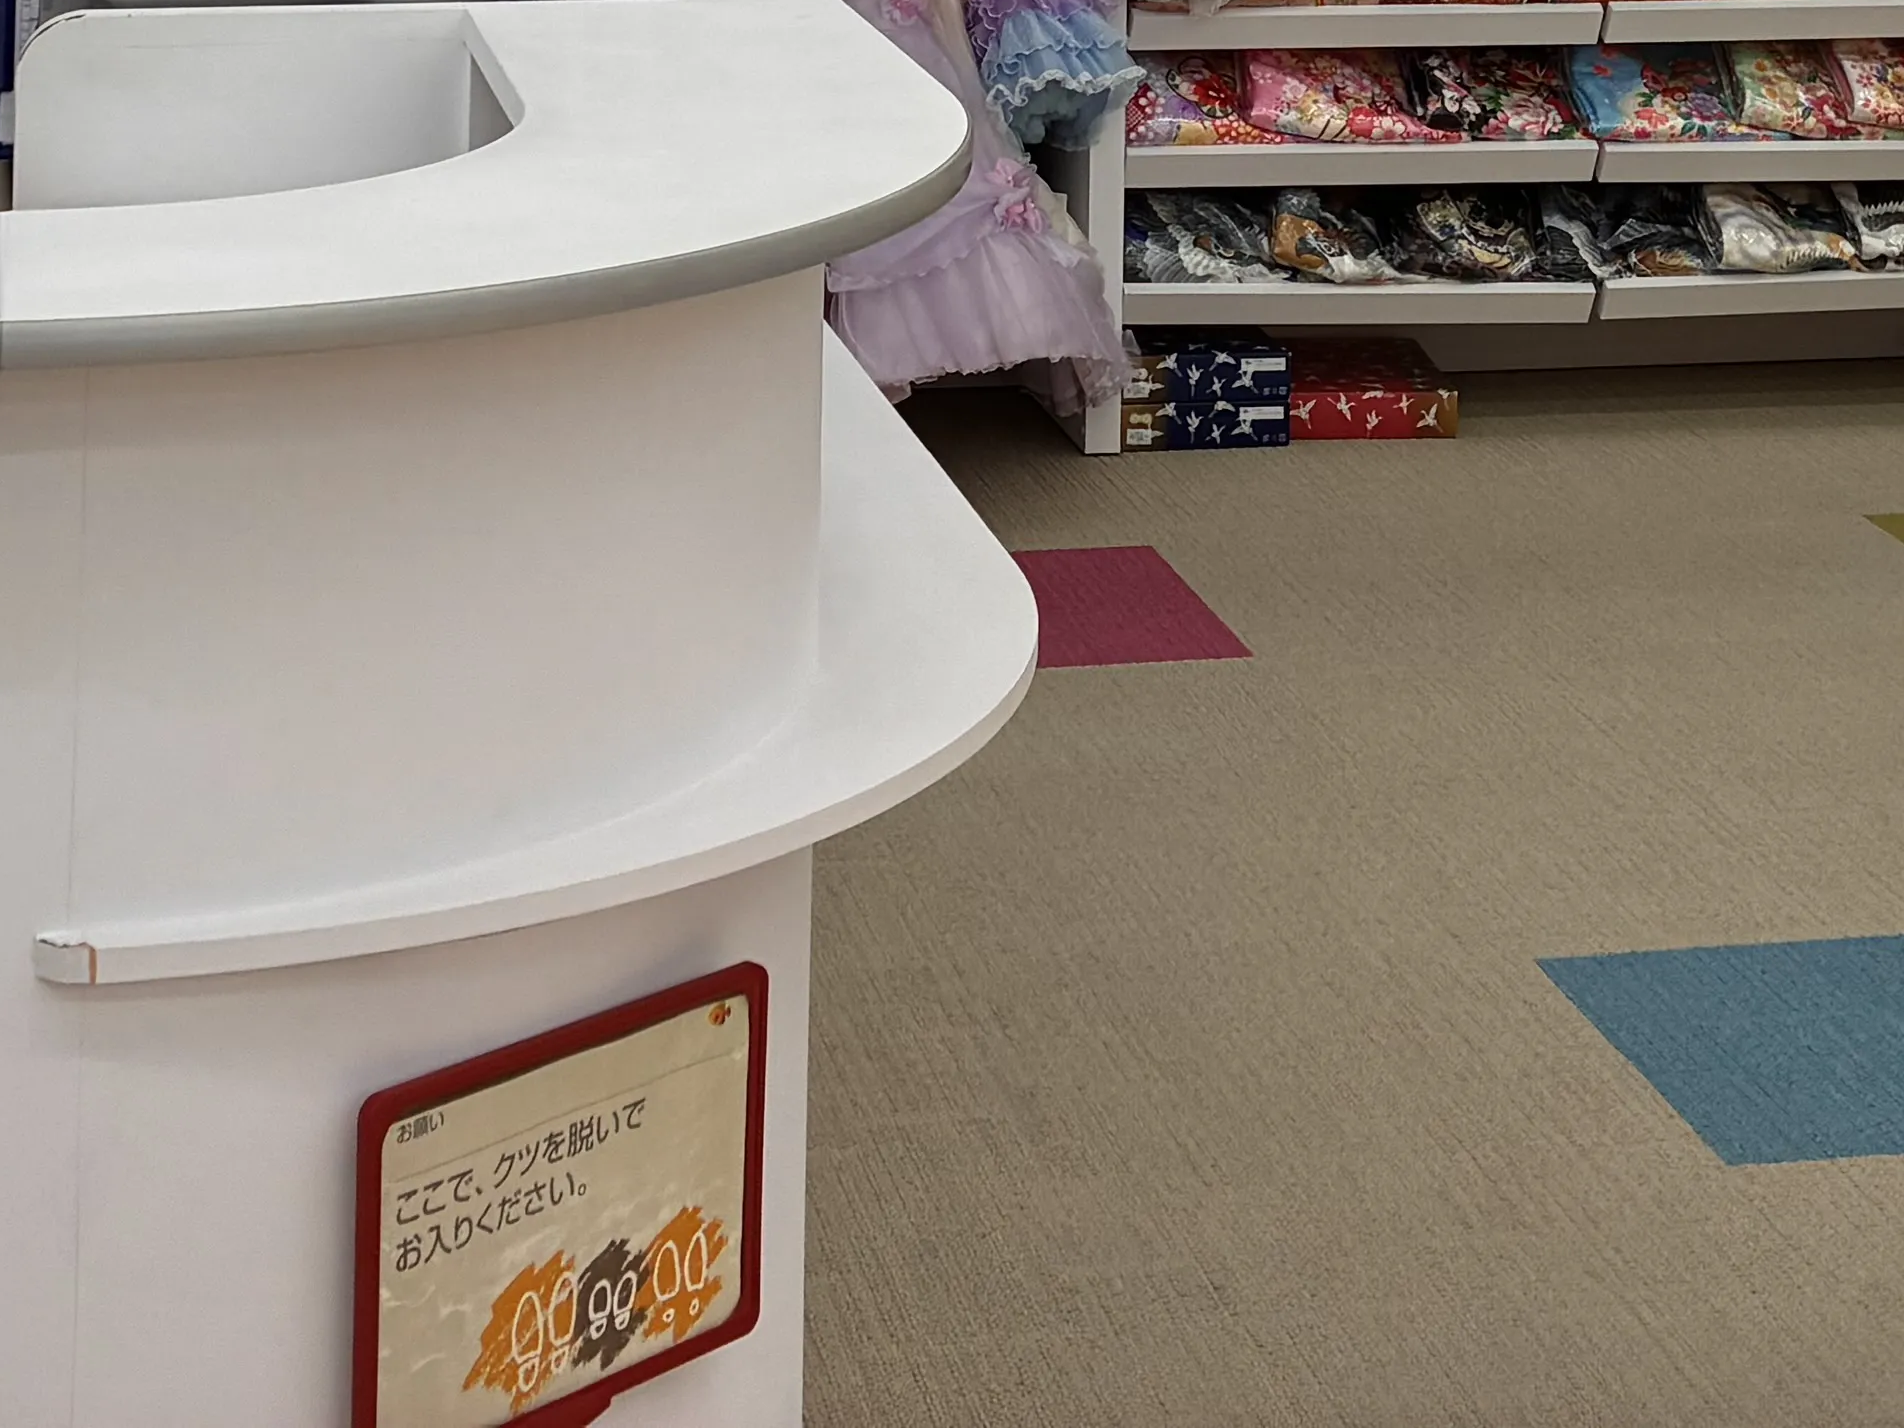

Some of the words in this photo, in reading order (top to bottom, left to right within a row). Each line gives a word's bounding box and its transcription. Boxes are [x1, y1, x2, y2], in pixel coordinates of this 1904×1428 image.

[396, 1111, 445, 1144] お願い
[396, 1097, 647, 1226] ここで、クツを脱いで
[395, 1172, 587, 1273] お入りください。
